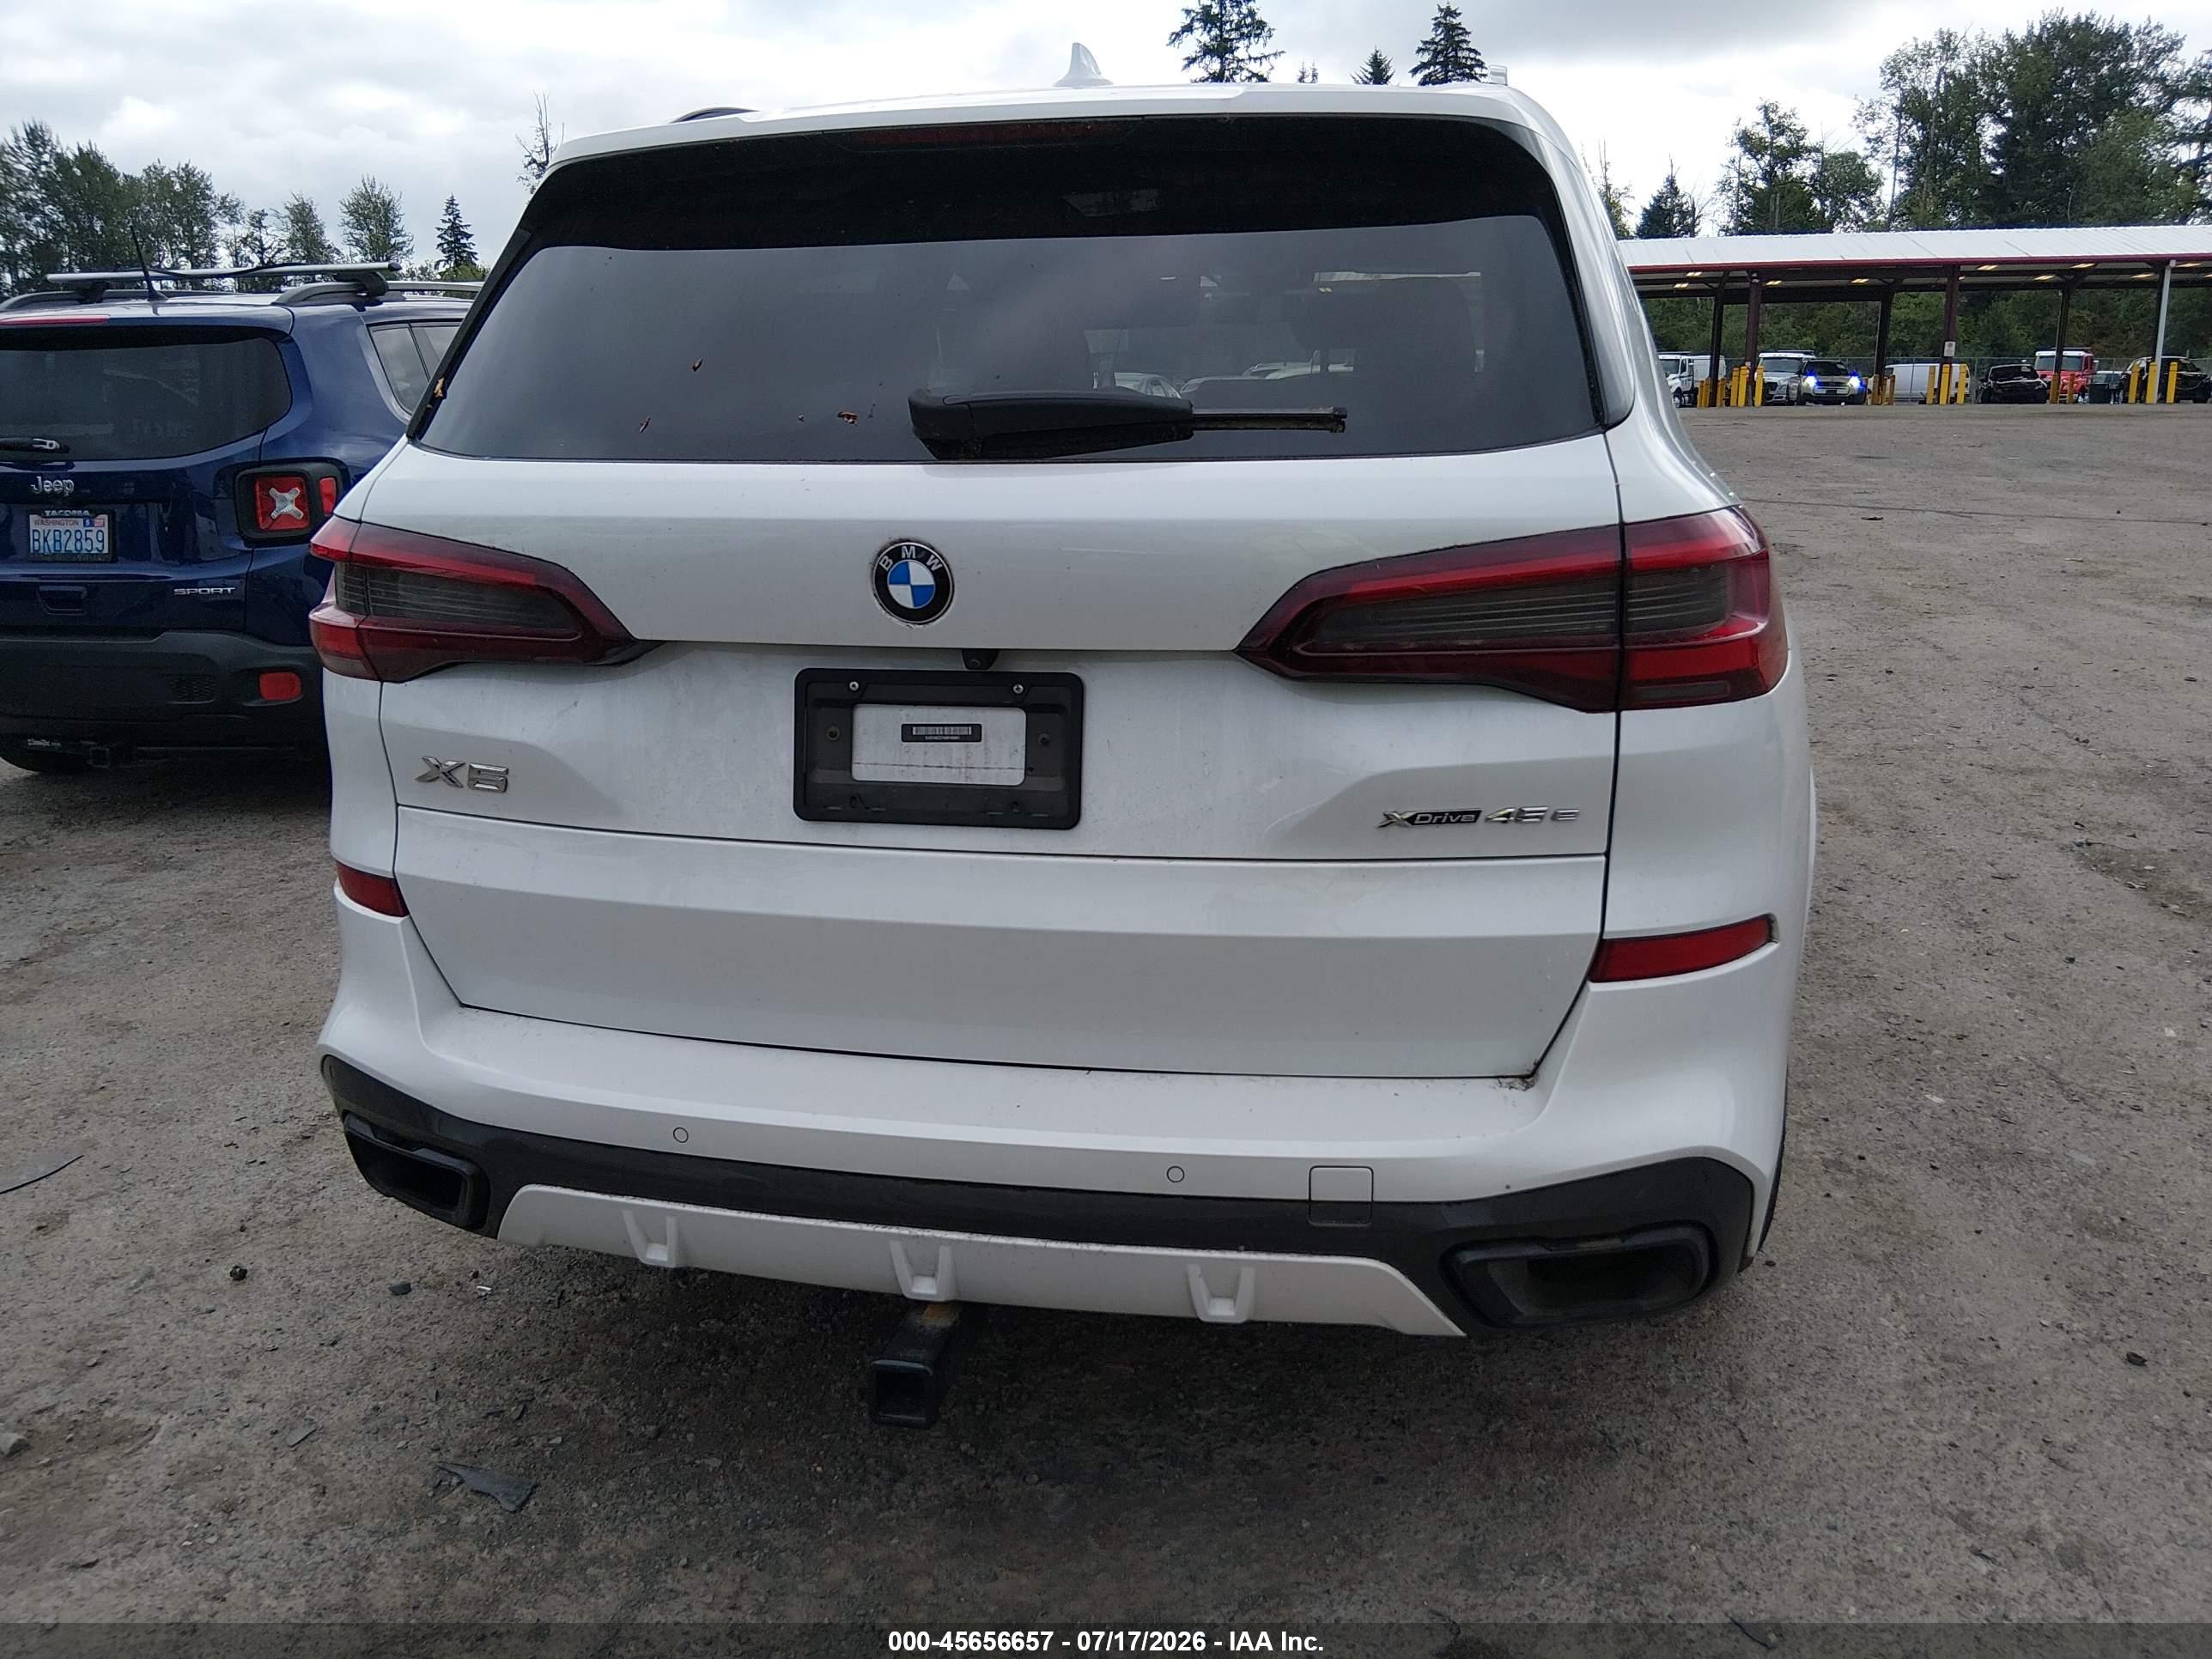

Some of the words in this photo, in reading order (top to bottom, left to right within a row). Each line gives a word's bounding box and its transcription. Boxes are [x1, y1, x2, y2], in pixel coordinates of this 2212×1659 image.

[30, 476, 75, 496] Jeep
[32, 529, 105, 553] BKB2859
[878, 545, 943, 572] BMW
[414, 756, 509, 793] X5
